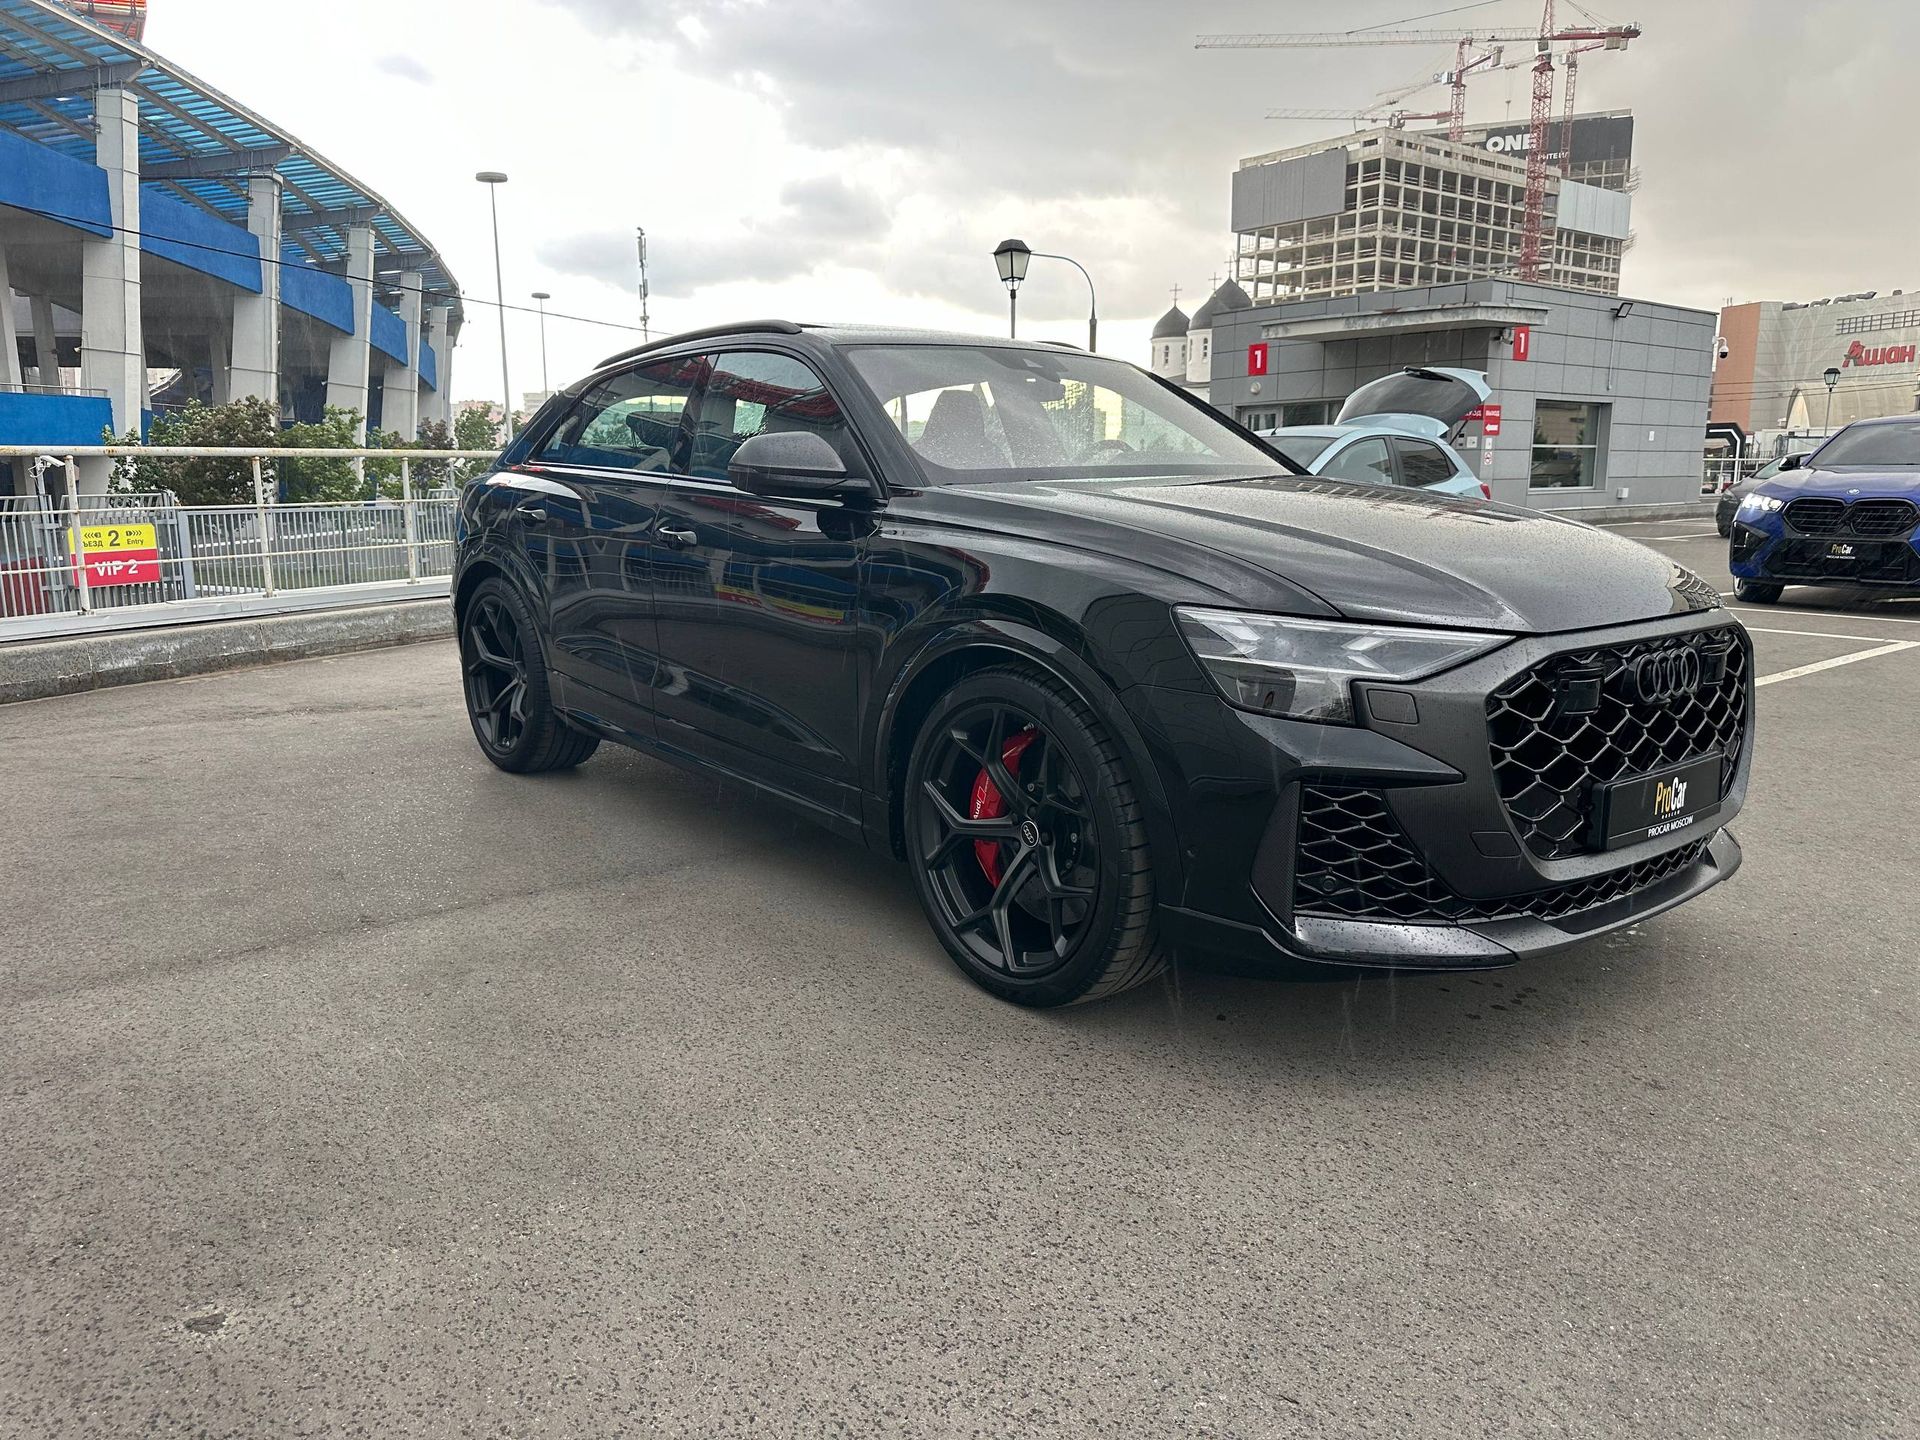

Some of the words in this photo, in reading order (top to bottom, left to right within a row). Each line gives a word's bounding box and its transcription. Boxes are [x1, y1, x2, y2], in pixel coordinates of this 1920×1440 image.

[1486, 133, 1538, 152] ONE
[1519, 332, 1526, 354] 1
[1254, 349, 1263, 369] 1
[82, 540, 104, 548] ЪЕЗД
[107, 529, 121, 547] 2
[126, 537, 145, 546] Entry
[95, 560, 123, 577] VIP
[128, 558, 139, 575] 2
[1654, 776, 1688, 816] ProCar
[1647, 822, 1670, 838] PROCAR
[1670, 815, 1694, 831] MOSCOW
